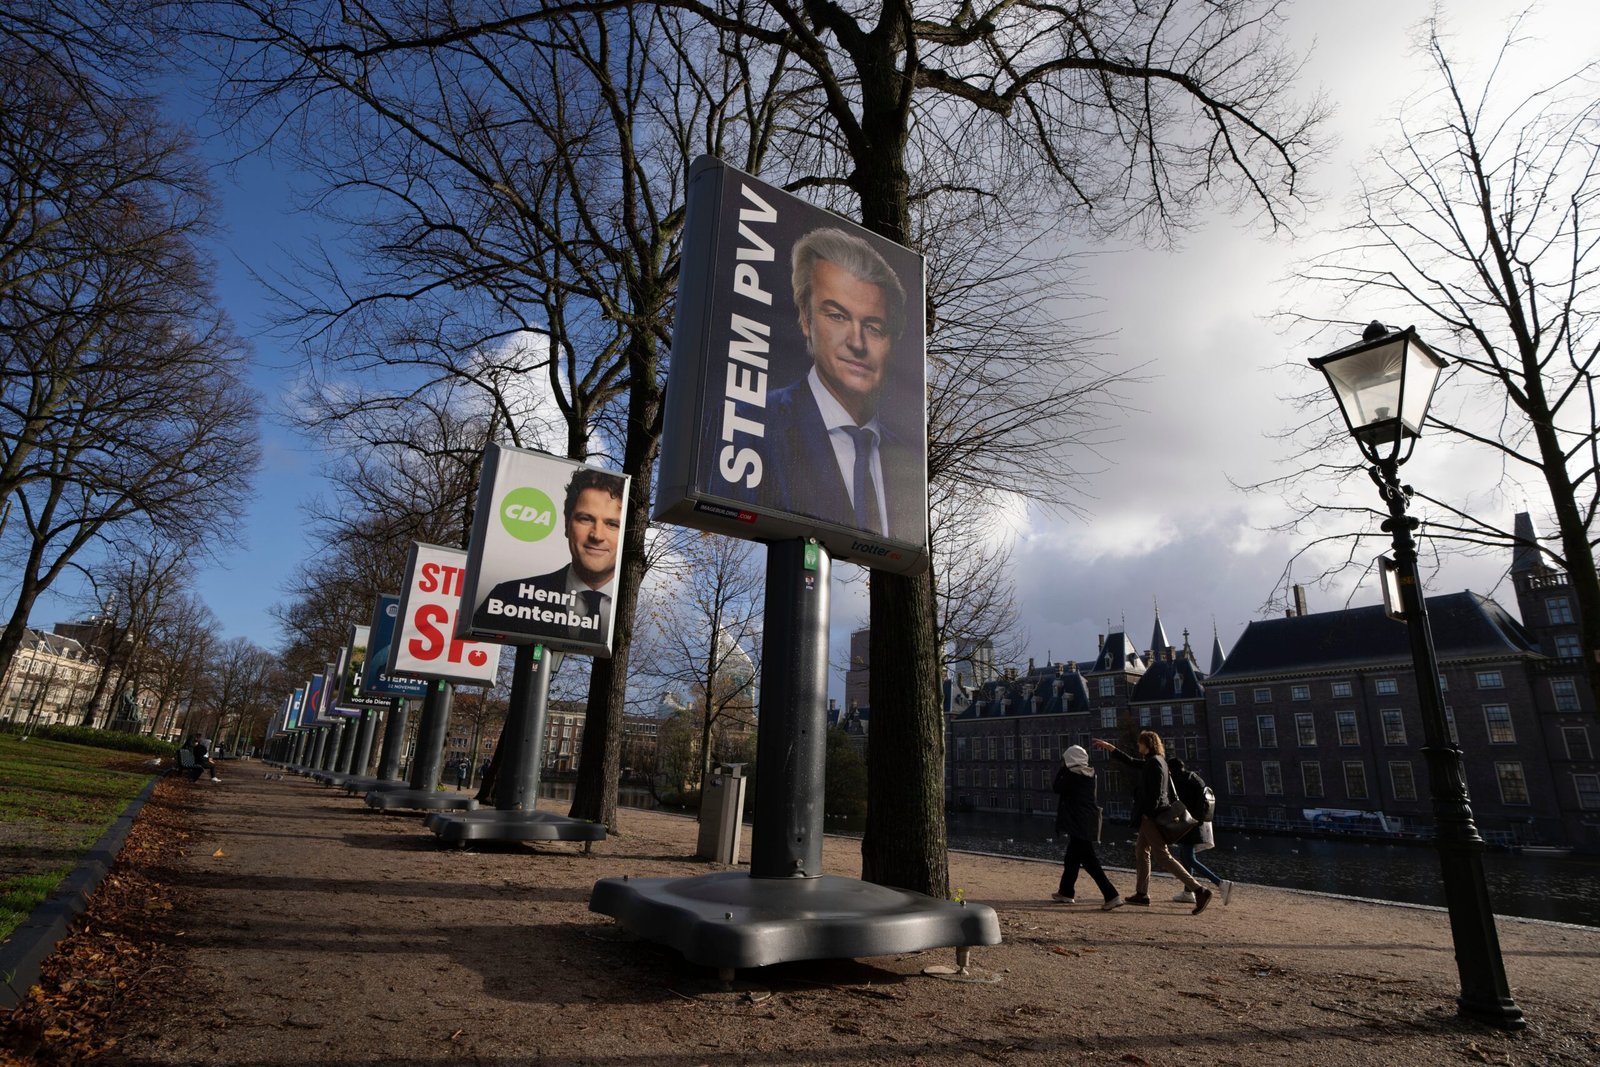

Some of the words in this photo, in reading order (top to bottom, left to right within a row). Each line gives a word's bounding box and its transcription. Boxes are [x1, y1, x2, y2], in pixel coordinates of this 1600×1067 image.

[733, 183, 778, 306] PVV
[719, 312, 772, 489] STEM
[504, 503, 551, 527] CDA
[518, 583, 577, 607] Henri
[487, 598, 600, 630] Bontenbal
